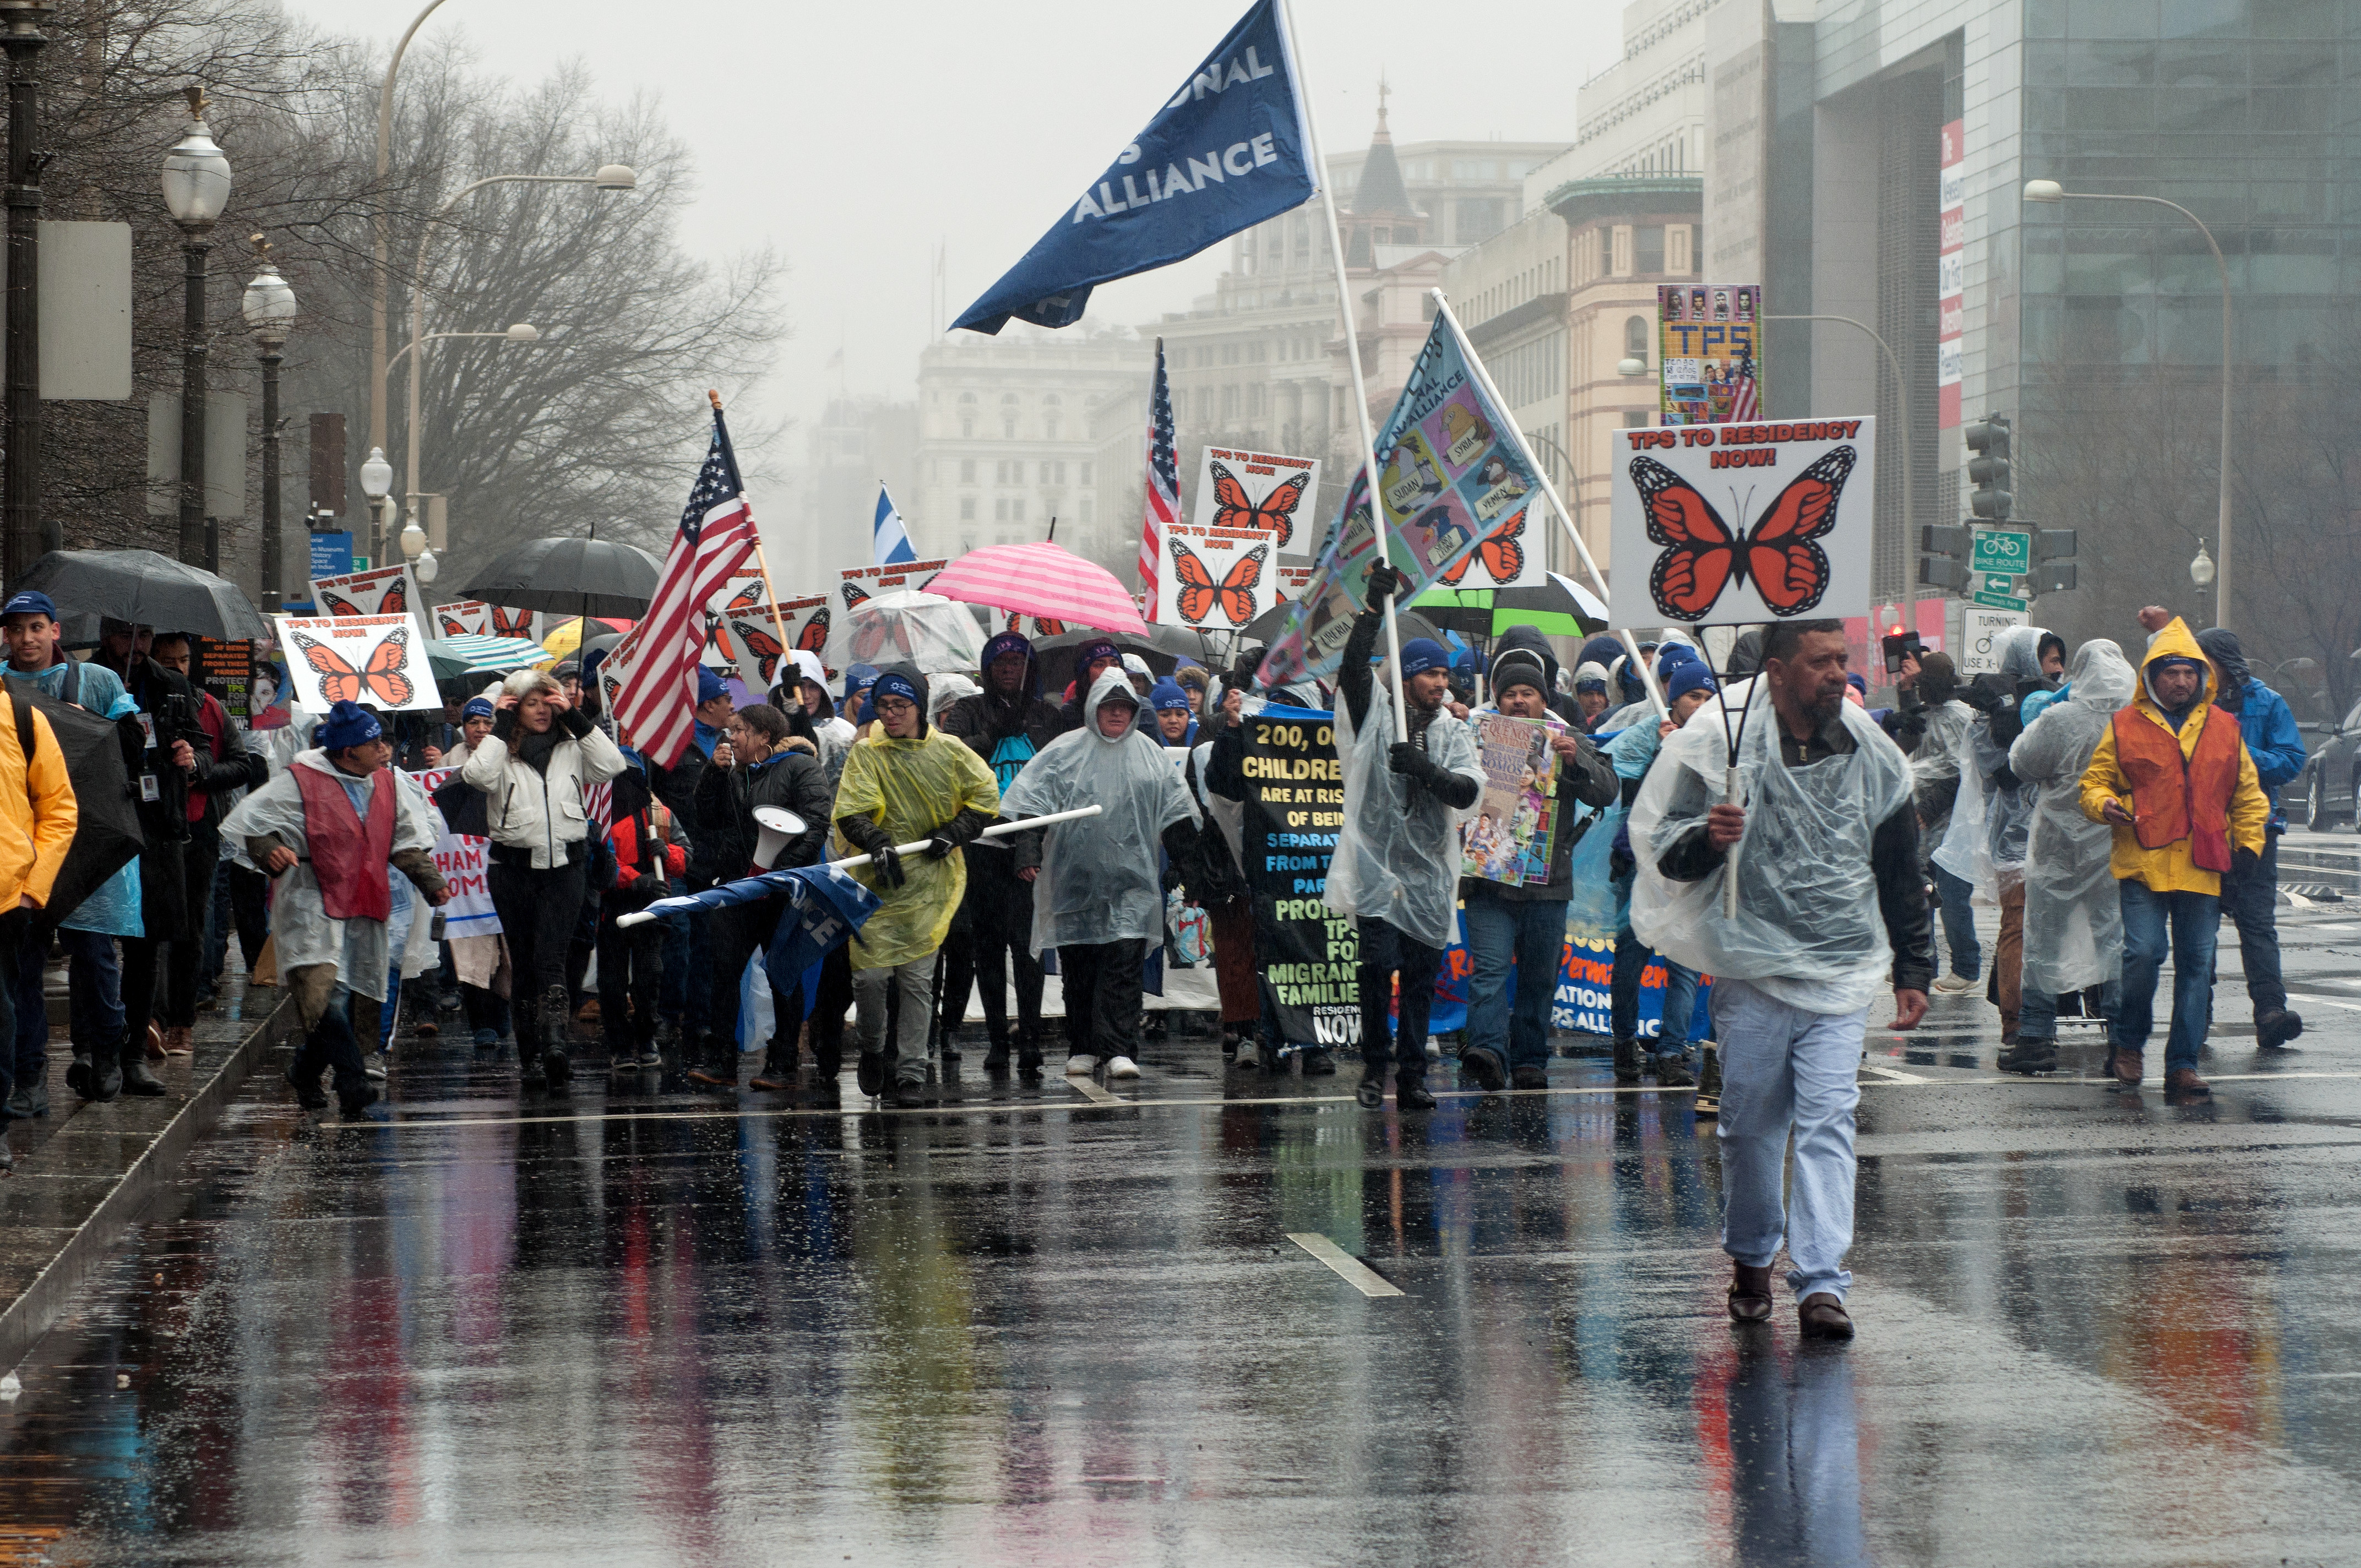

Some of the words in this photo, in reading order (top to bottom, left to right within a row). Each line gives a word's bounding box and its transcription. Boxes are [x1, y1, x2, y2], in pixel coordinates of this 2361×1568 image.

[1072, 132, 1279, 224] ALLIANCE
[1671, 325, 1752, 356] TPS
[1664, 358, 1694, 367] Tengo
[1407, 369, 1465, 426] ALLIANCE
[1628, 431, 1676, 450] TPS
[1681, 429, 1716, 447] TO
[1721, 420, 1862, 445] RESIDENCY
[1454, 437, 1474, 458] SYRIA
[1211, 449, 1232, 460] TPS
[1234, 452, 1249, 461] TO
[1252, 454, 1315, 470] RESIDENCY
[1710, 448, 1777, 469] NOW!
[1245, 464, 1275, 476] NOW!
[1393, 477, 1420, 501] SUDAN
[1168, 525, 1189, 535] TPS
[1192, 527, 1206, 536] TO
[1209, 527, 1271, 541] RESIDENCY
[1204, 539, 1234, 549] NOW!
[842, 569, 863, 580] TPS
[866, 567, 881, 577] TO
[884, 559, 948, 575] RESIDENCY
[1975, 557, 1994, 565] BIKE
[1996, 558, 2026, 568] ROUTE
[315, 580, 336, 590] TPS
[335, 577, 350, 586] TO
[350, 566, 404, 584] RESIDENCY
[726, 609, 748, 619] TPS
[749, 606, 765, 616] TO
[766, 596, 826, 614] RSIDENCY
[285, 620, 311, 629] TPS
[313, 619, 330, 628] TO
[333, 615, 406, 627] RESIDENCY
[765, 612, 796, 624] NW!
[1978, 616, 2017, 627] TURNING
[331, 628, 367, 638] NOW!
[1964, 657, 1983, 668] USE
[205, 677, 248, 685] PROTECT
[227, 684, 246, 693] TPS
[1256, 724, 1309, 752] 200,
[1481, 758, 1523, 776] SOMOS
[1261, 786, 1292, 803] ARE
[1294, 788, 1314, 803] AT
[1287, 810, 1309, 827] OF
[1266, 854, 1318, 872] FROM
[1326, 940, 1359, 961] FO
